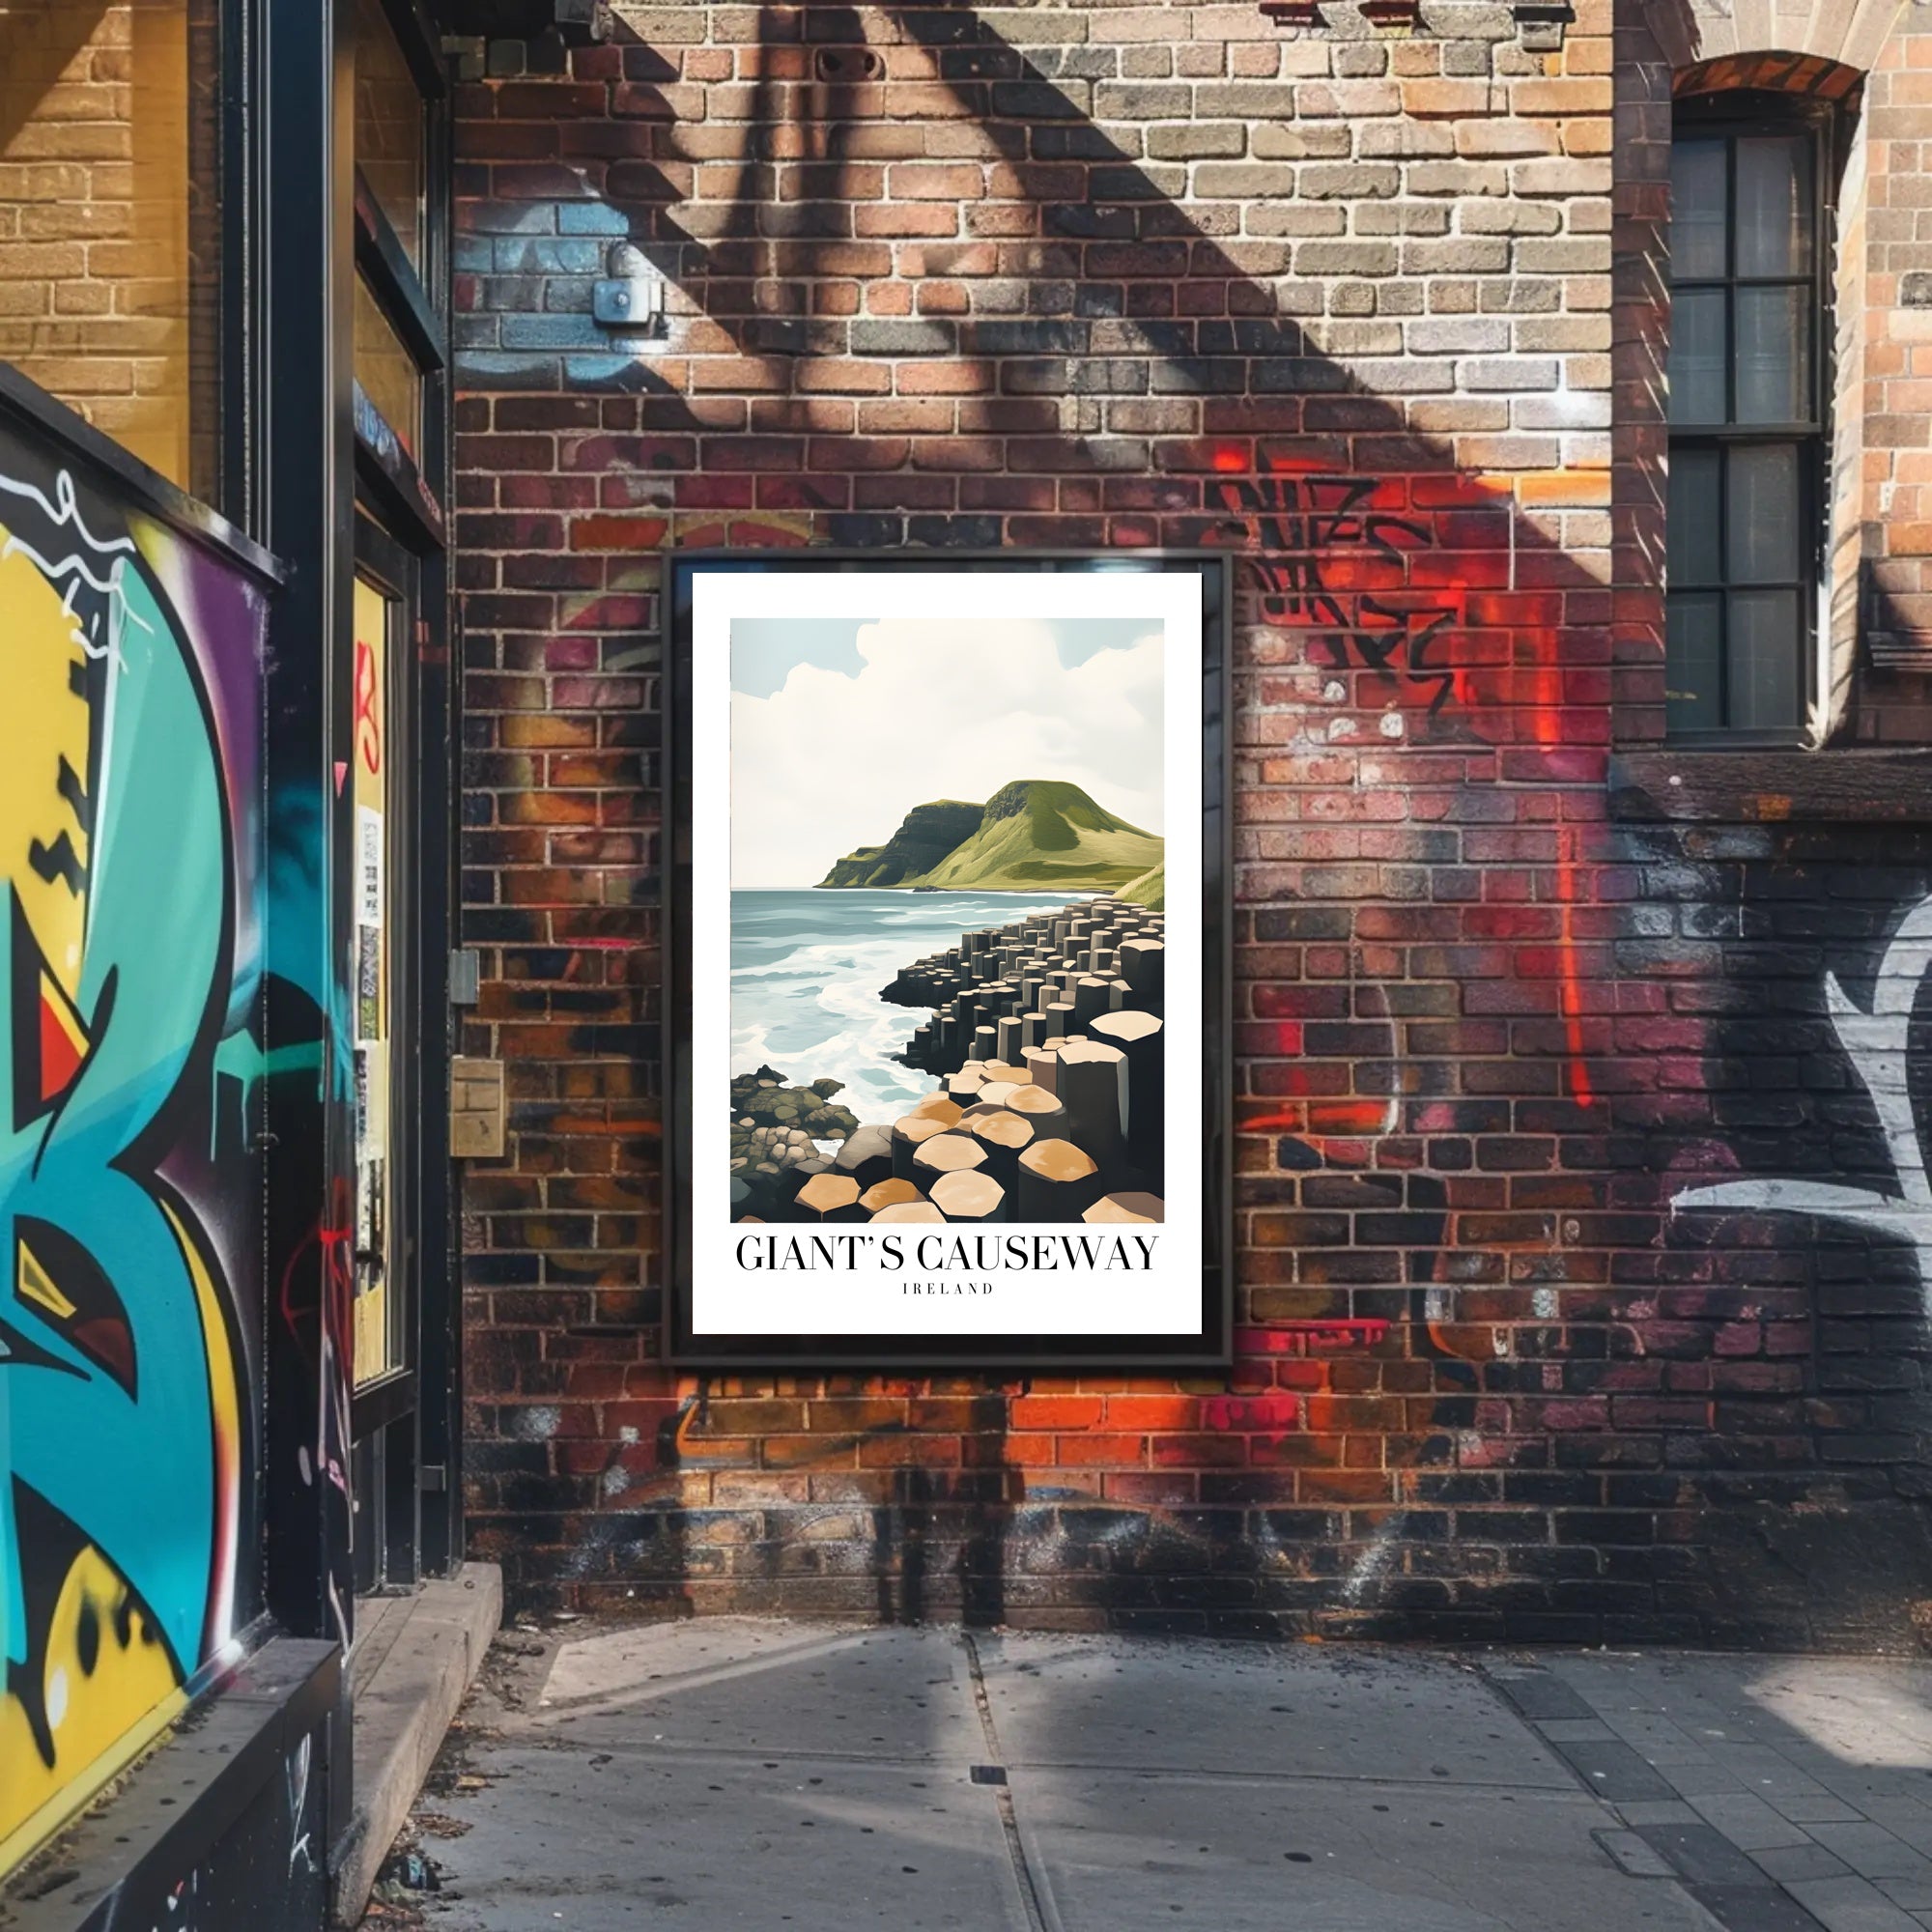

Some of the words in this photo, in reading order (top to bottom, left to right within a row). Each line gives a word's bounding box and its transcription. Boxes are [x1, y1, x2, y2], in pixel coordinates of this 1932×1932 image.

[735, 1235, 905, 1271] GIANT’S
[916, 1235, 1160, 1271] CAUSEWAY
[902, 1281, 994, 1295] IRELAND
